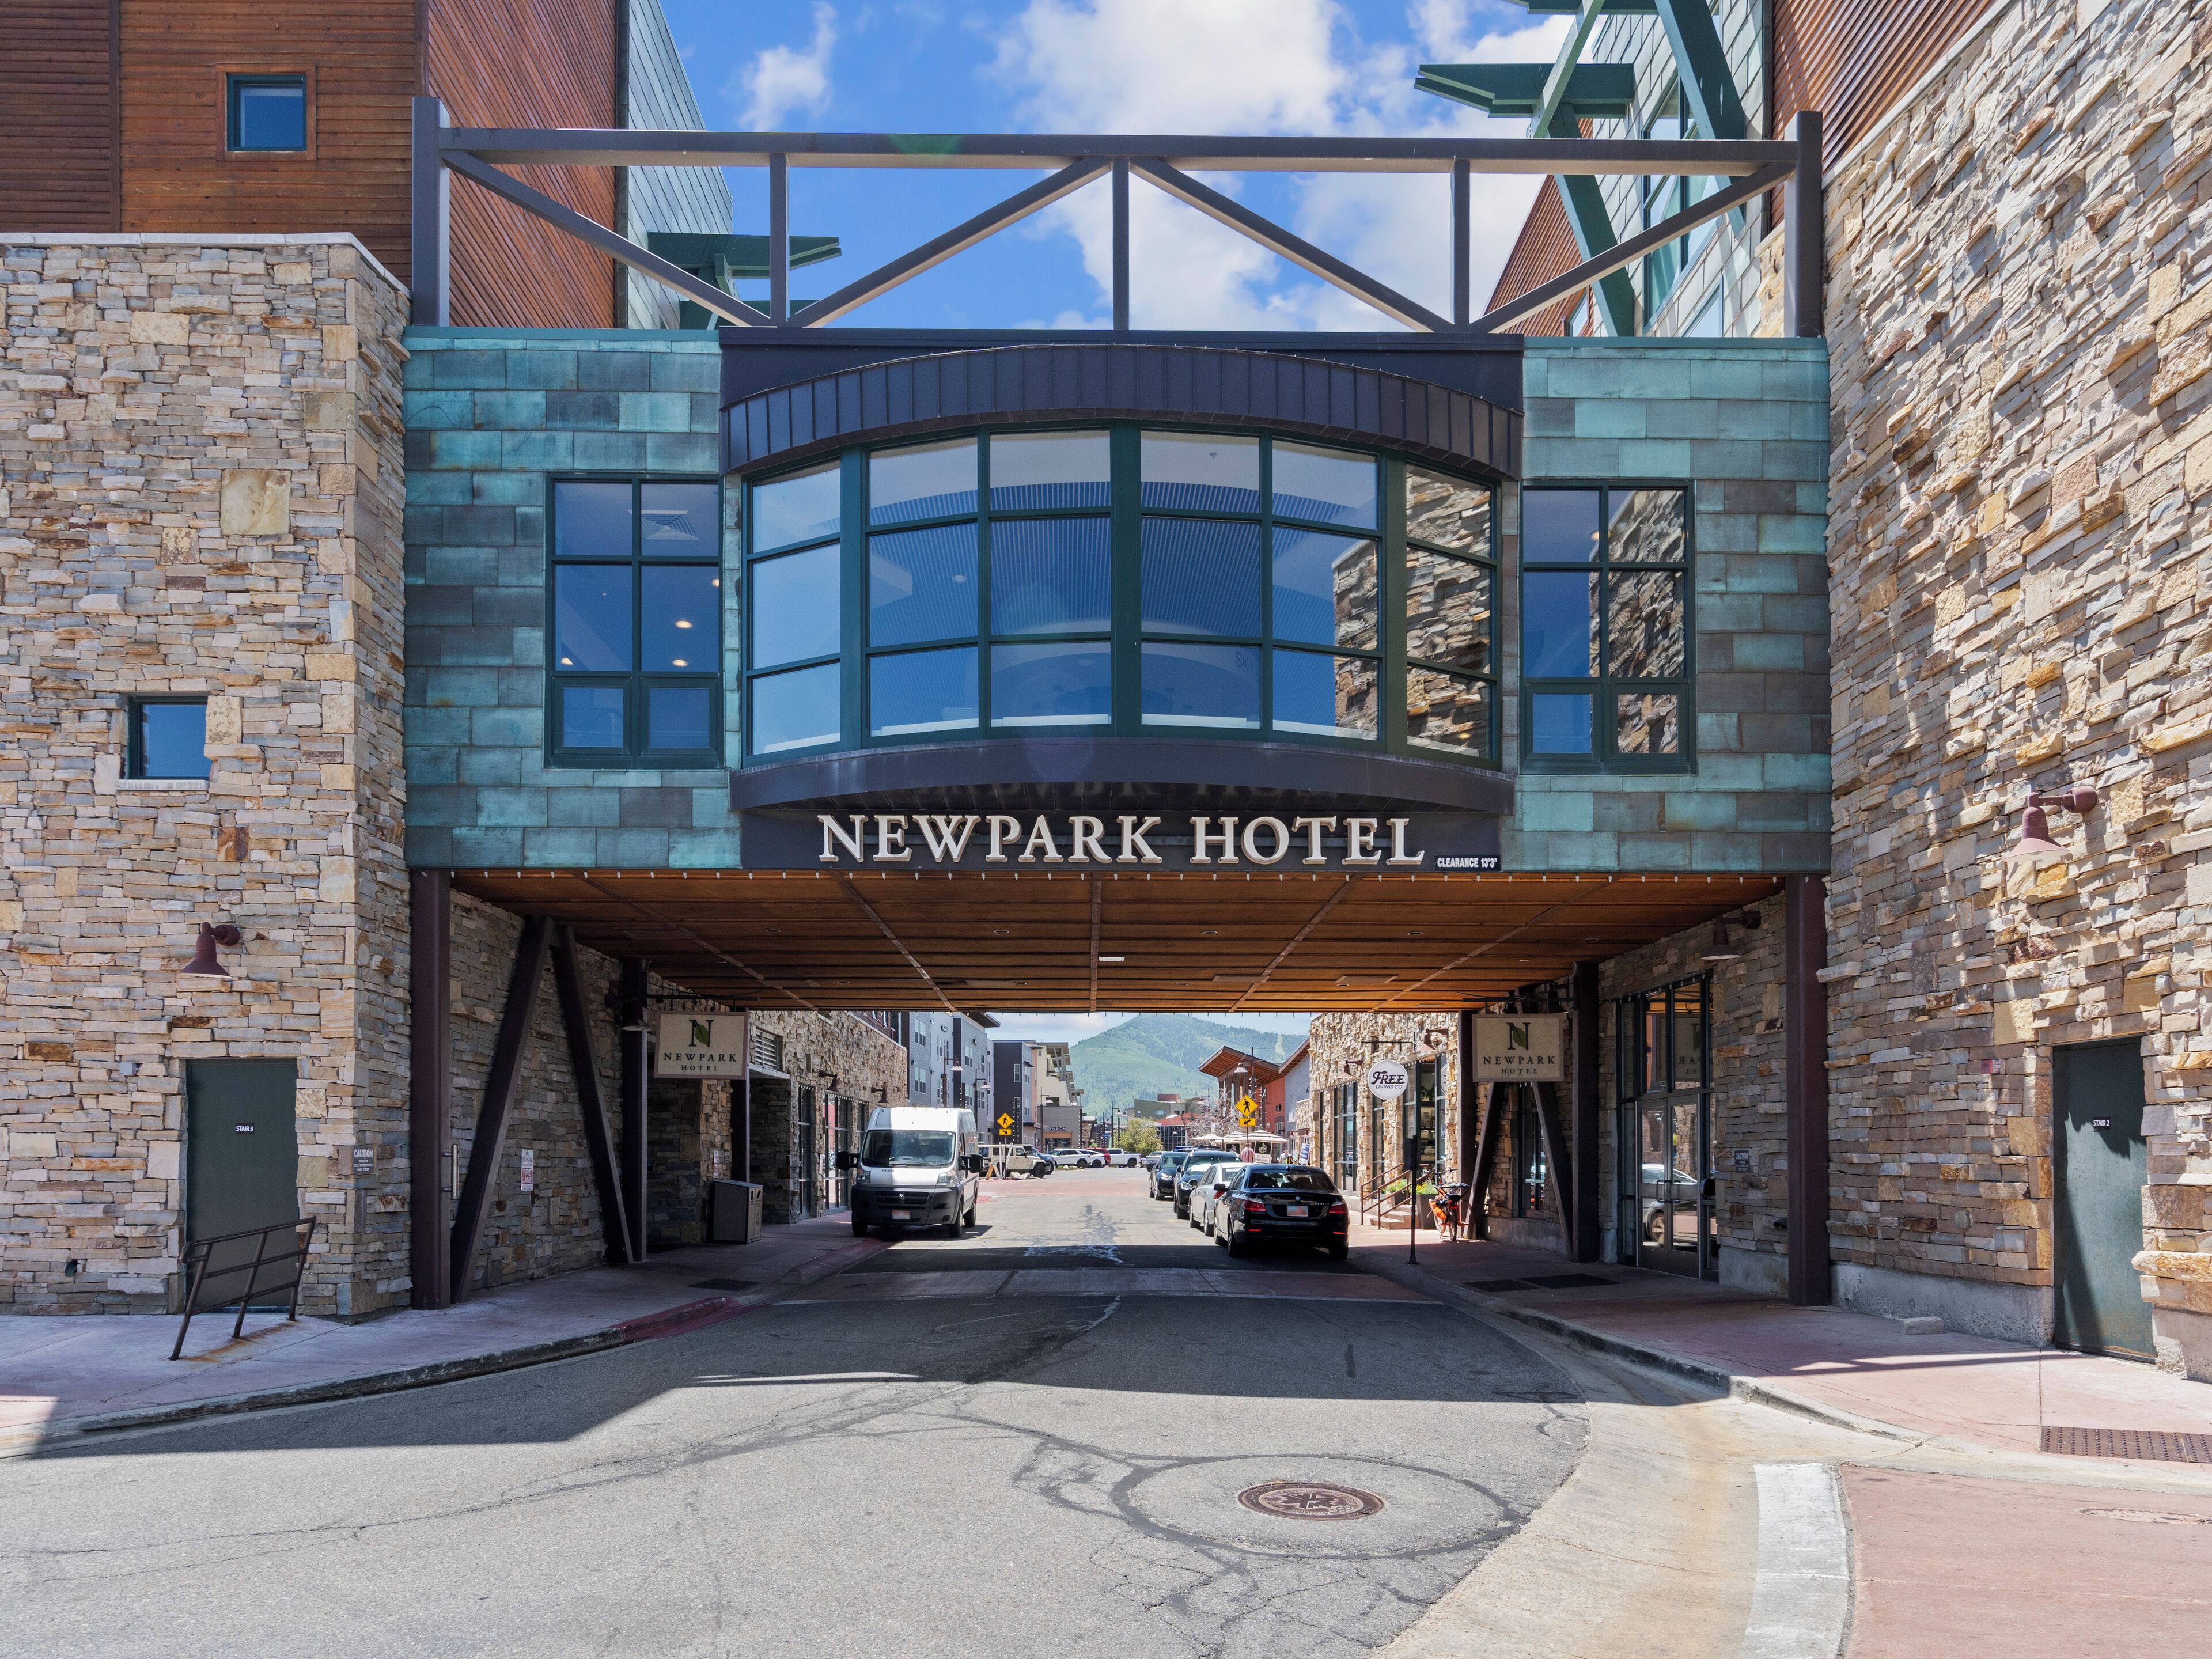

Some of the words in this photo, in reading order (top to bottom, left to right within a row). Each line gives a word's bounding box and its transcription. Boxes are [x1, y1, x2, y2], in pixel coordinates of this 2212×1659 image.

[817, 815, 1162, 863] NEWPARK
[1190, 816, 1425, 865] HOTEL
[1437, 857, 1479, 868] CLEARANCE
[1481, 858, 1498, 868] 13'3"
[664, 1052, 737, 1062] NEWPARK
[1483, 1056, 1555, 1065] NEWPARK
[1370, 1070, 1405, 1085] FREE
[354, 1149, 373, 1158] CAUTION
